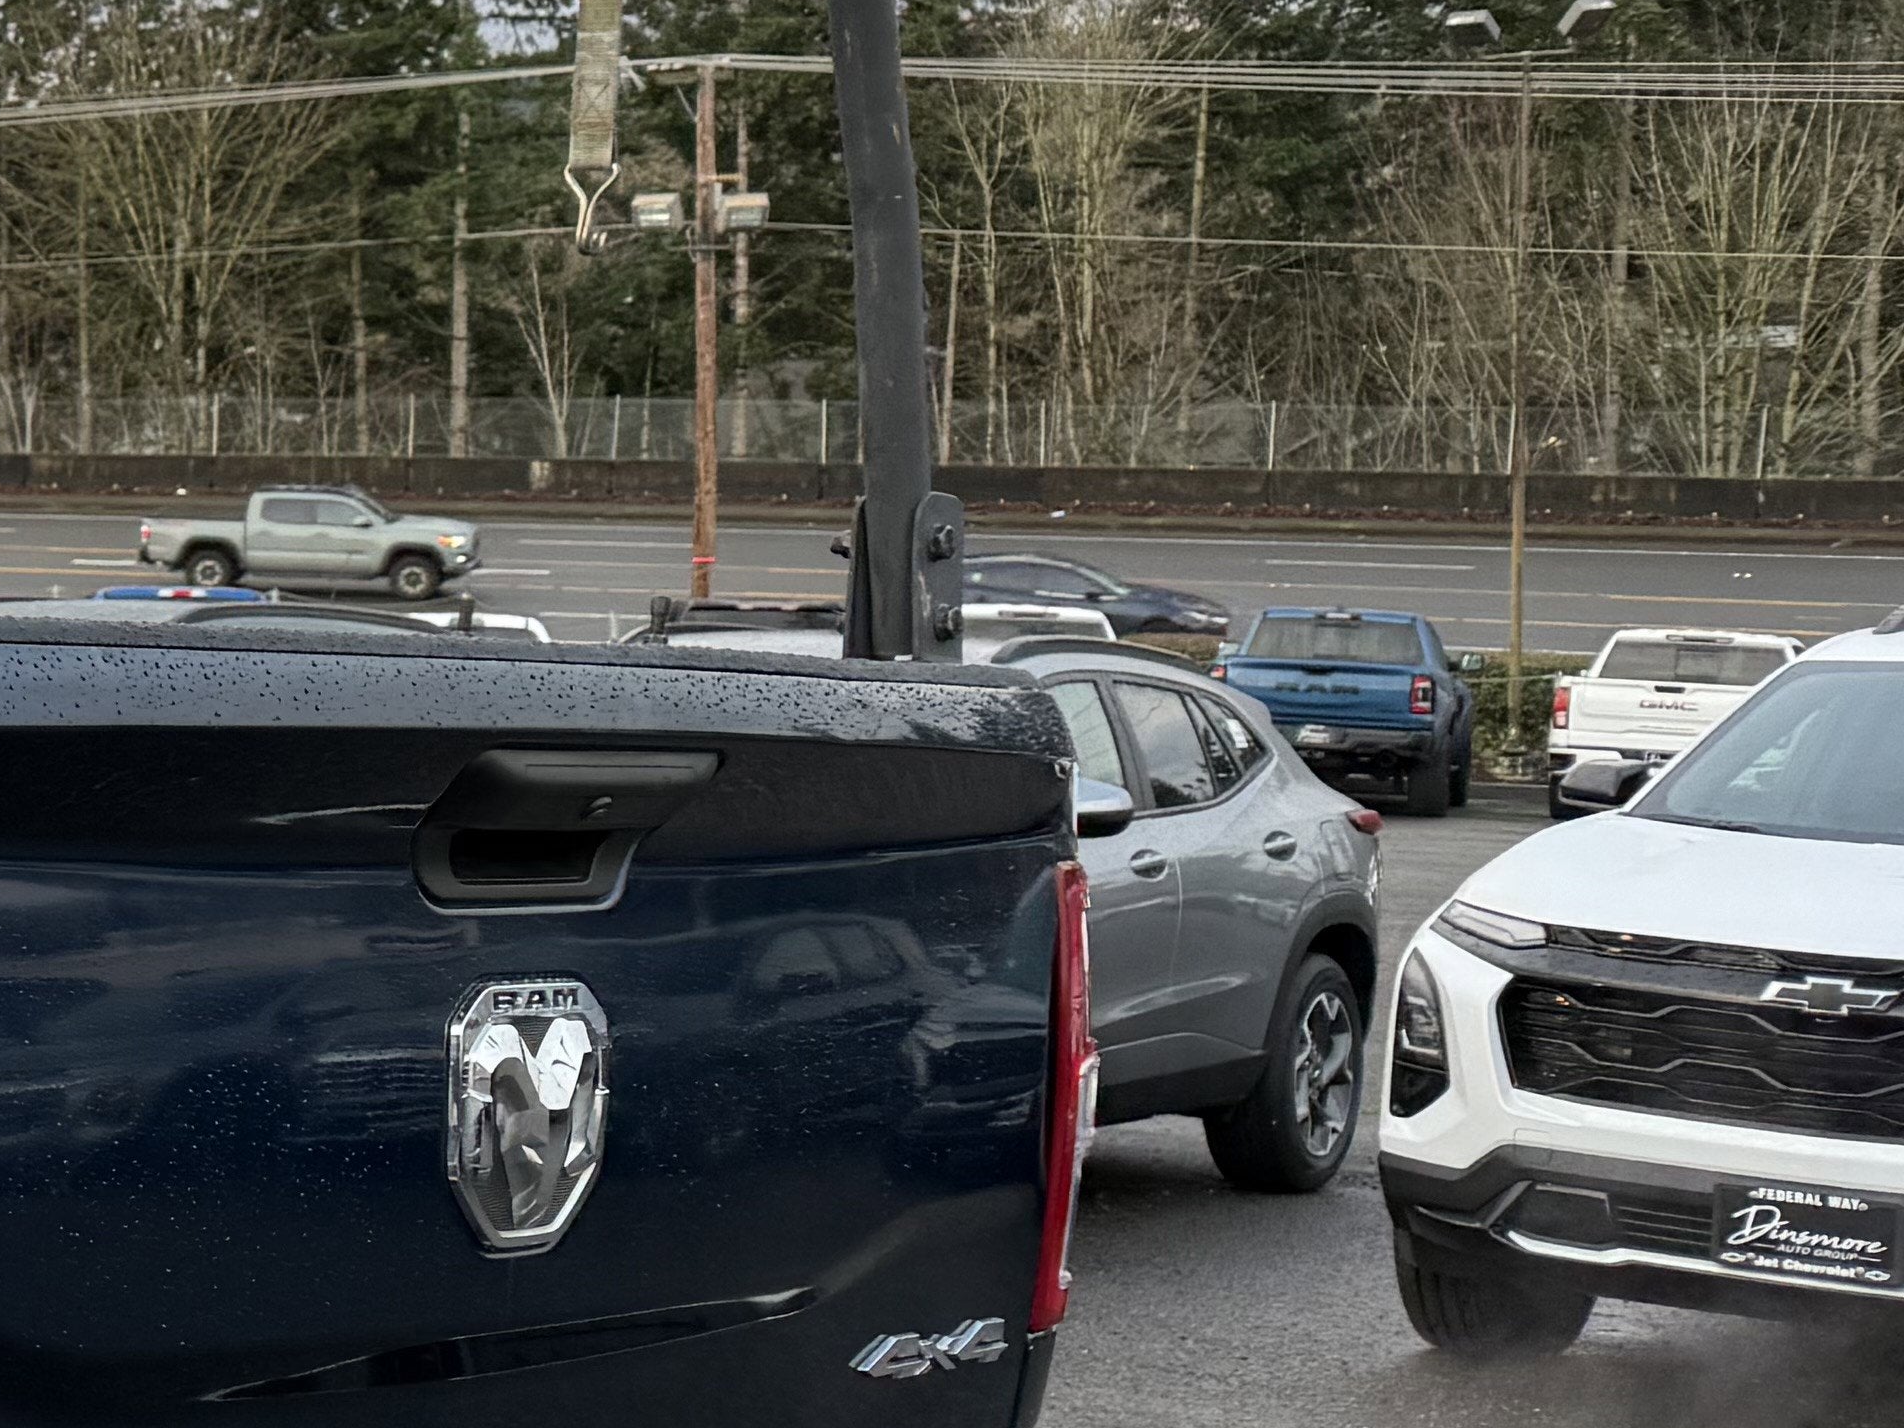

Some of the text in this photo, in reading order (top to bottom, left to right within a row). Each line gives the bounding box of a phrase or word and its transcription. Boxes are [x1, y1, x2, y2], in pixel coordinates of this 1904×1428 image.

[1639, 700, 1698, 711] GMC
[492, 986, 581, 1013] RAM
[1758, 1187, 1860, 1210] FEDERAL WAY
[1727, 1205, 1887, 1253] Dinsmore
[1777, 1244, 1858, 1260] AUTO GROUP
[1754, 1256, 1855, 1278] Jet Chevrolet
